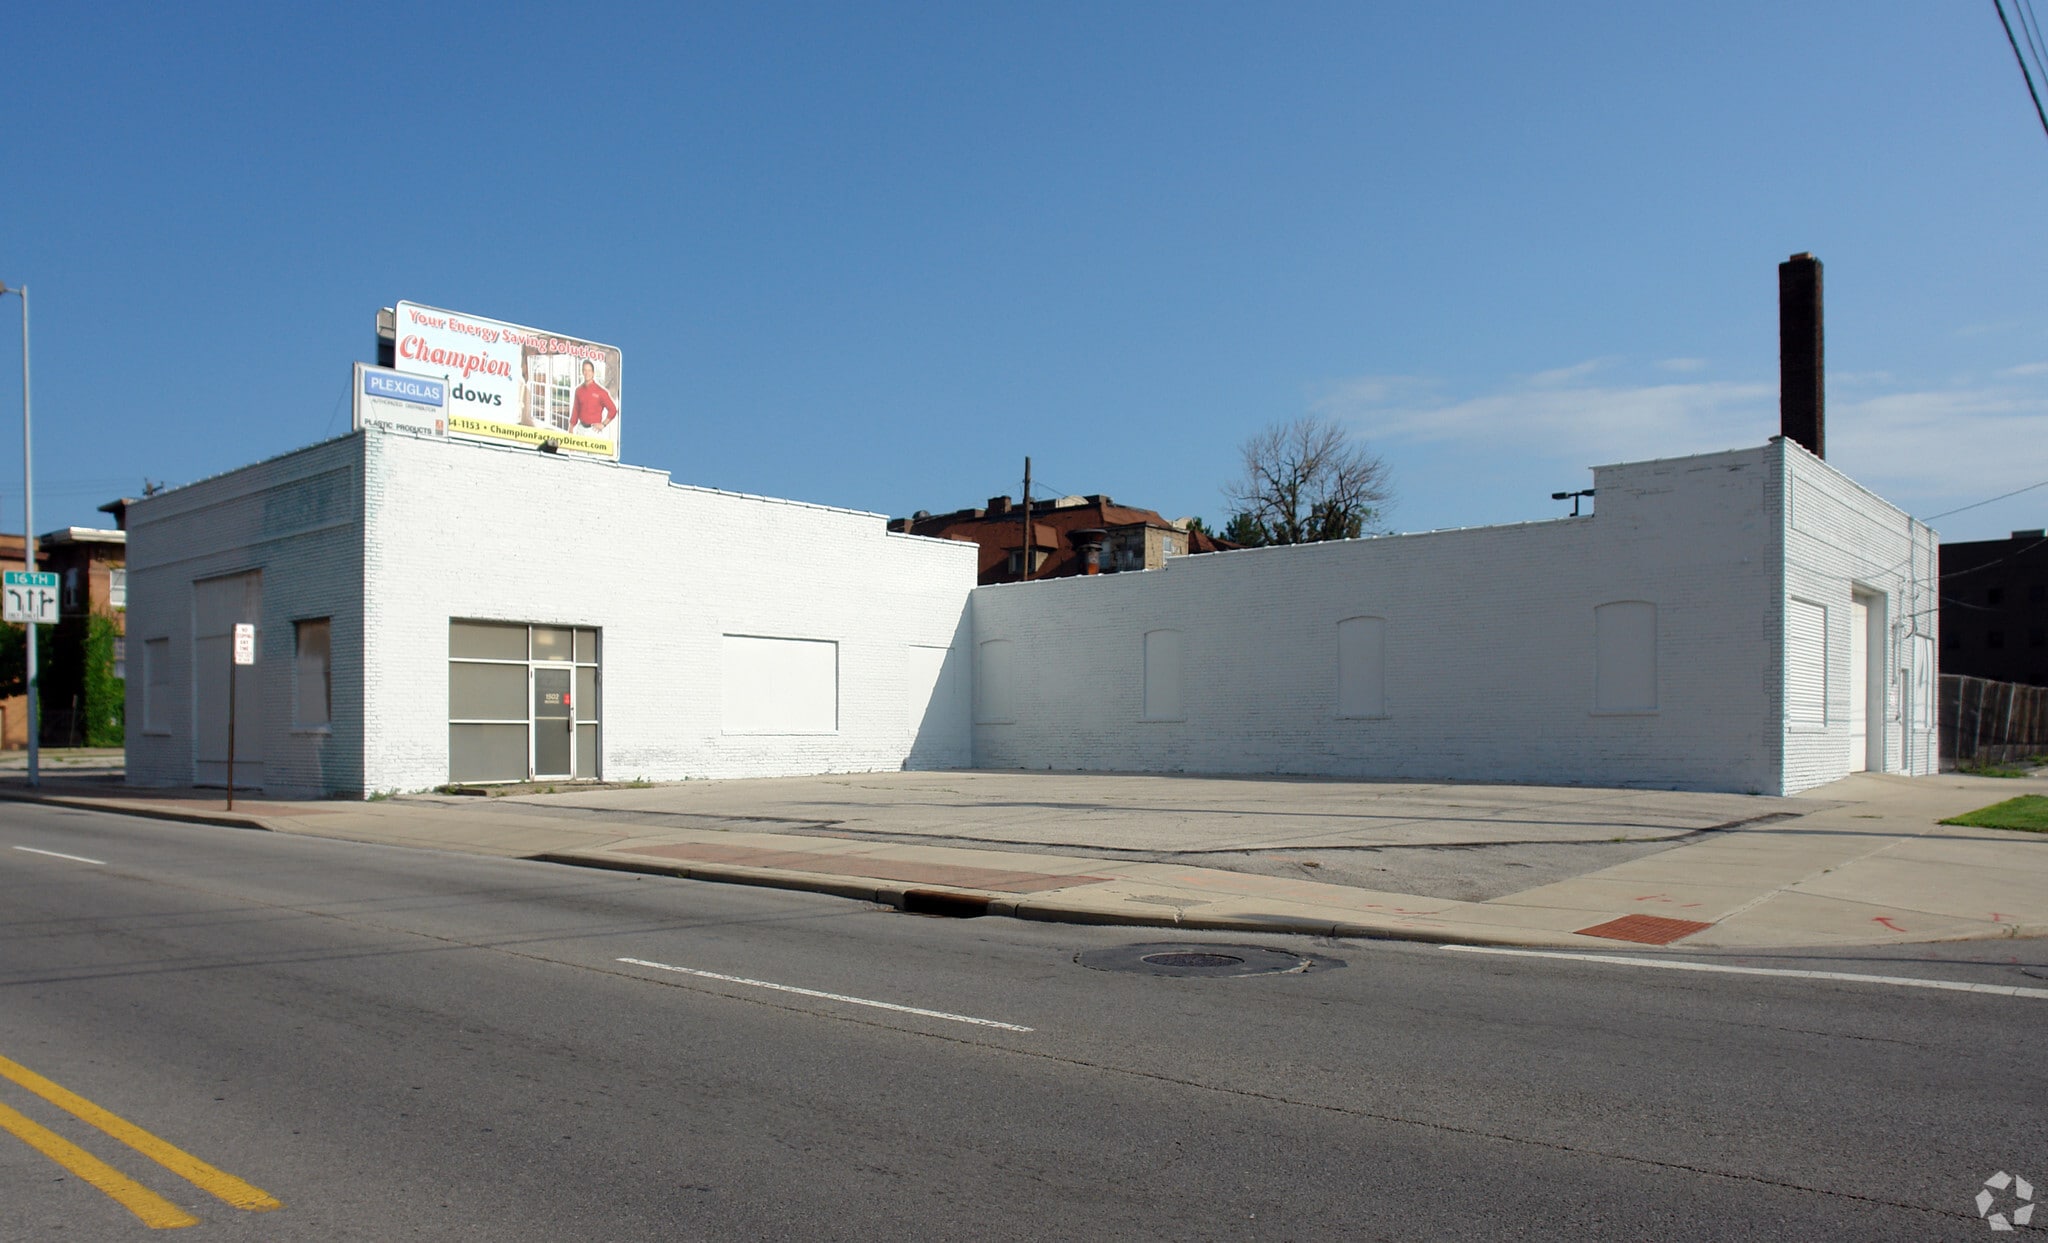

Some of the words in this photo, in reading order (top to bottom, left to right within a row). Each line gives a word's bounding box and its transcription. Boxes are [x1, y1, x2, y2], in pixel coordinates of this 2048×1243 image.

[408, 308, 446, 329] Your
[448, 318, 499, 343] Energy
[502, 329, 547, 353] Saving
[549, 338, 605, 361] Solution
[399, 335, 513, 378] Champion
[370, 376, 440, 399] PLEXIGLAS
[364, 418, 393, 429] PLASTIC
[395, 423, 432, 435] PRODUCTS
[490, 424, 607, 450] ChampionFactoryDirect.com
